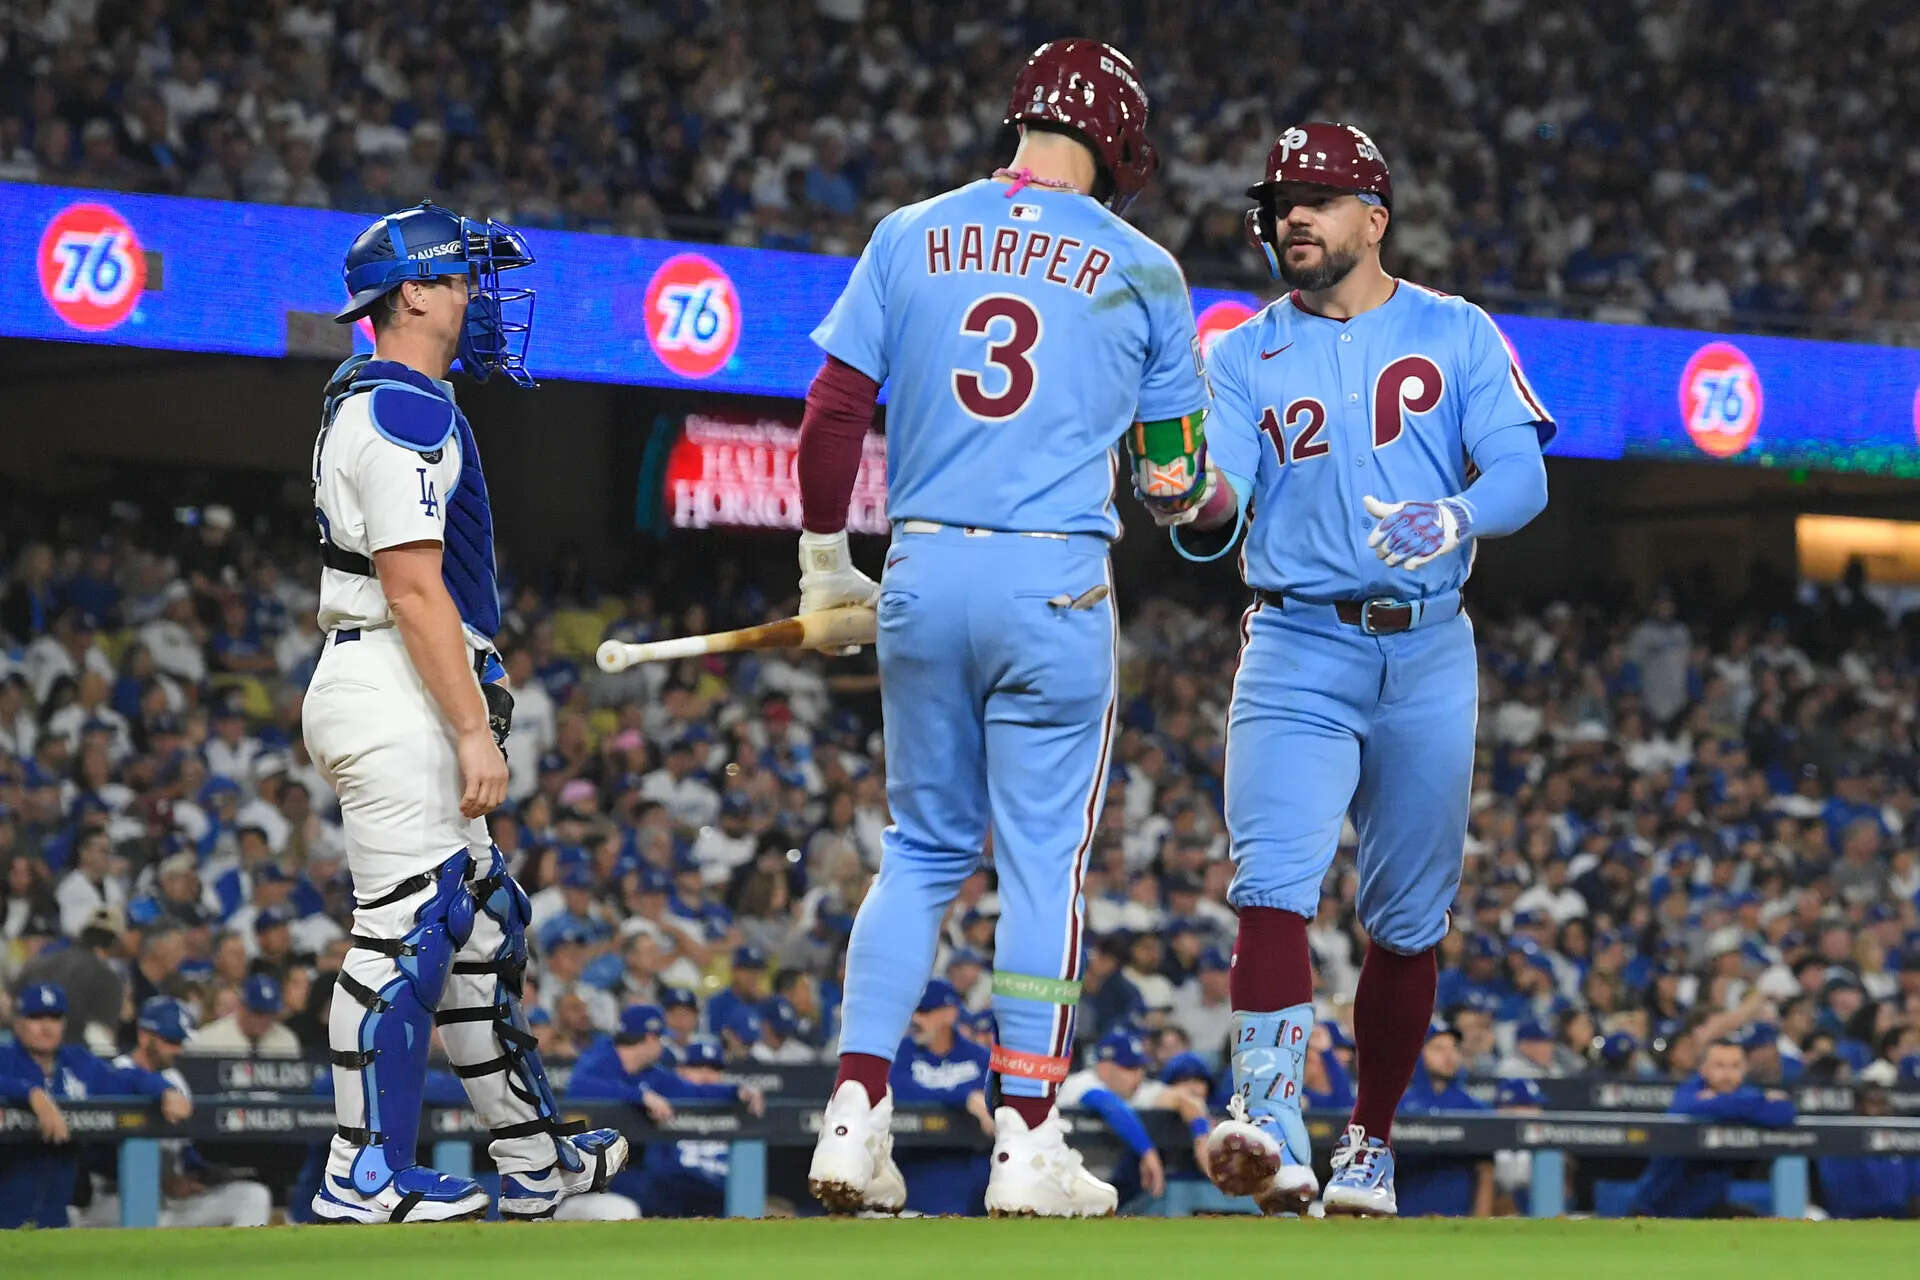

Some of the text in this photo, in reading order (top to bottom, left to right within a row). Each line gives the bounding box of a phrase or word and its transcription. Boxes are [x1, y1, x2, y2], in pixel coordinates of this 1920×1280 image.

[56, 233, 131, 303] 76
[925, 223, 1112, 297] HARPER
[658, 281, 728, 351] 76
[951, 293, 1043, 422] 3
[1258, 397, 1330, 467] 12
[1373, 354, 1445, 450] P
[1692, 368, 1751, 432] 76
[416, 468, 441, 520] LA
[366, 1170, 377, 1181] 16
